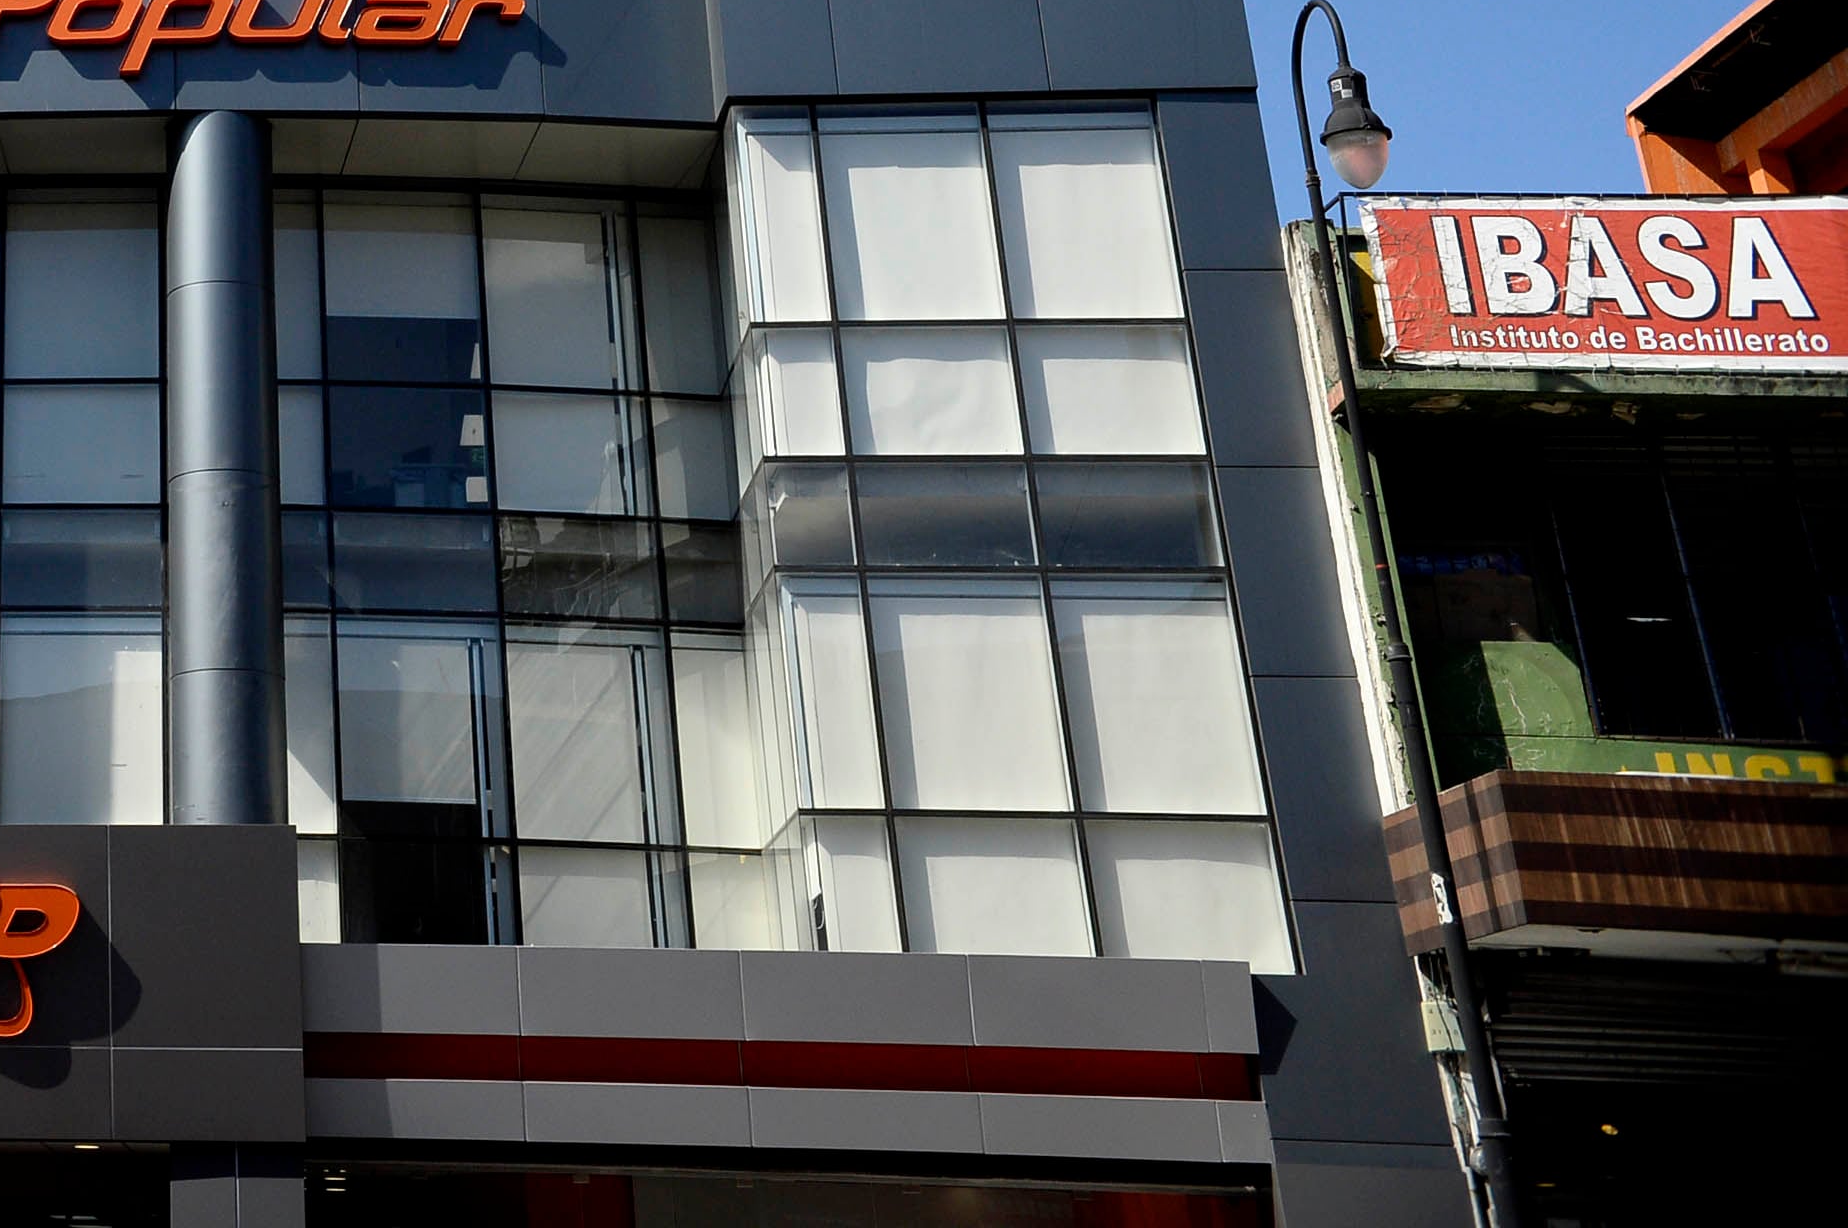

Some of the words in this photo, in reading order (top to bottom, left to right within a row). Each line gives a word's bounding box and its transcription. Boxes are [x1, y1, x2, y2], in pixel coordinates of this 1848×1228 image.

[1429, 215, 1820, 321] IBASA
[1449, 324, 1580, 350] Instituto
[1589, 325, 1627, 350] de
[1634, 326, 1830, 352] Bachillerato
